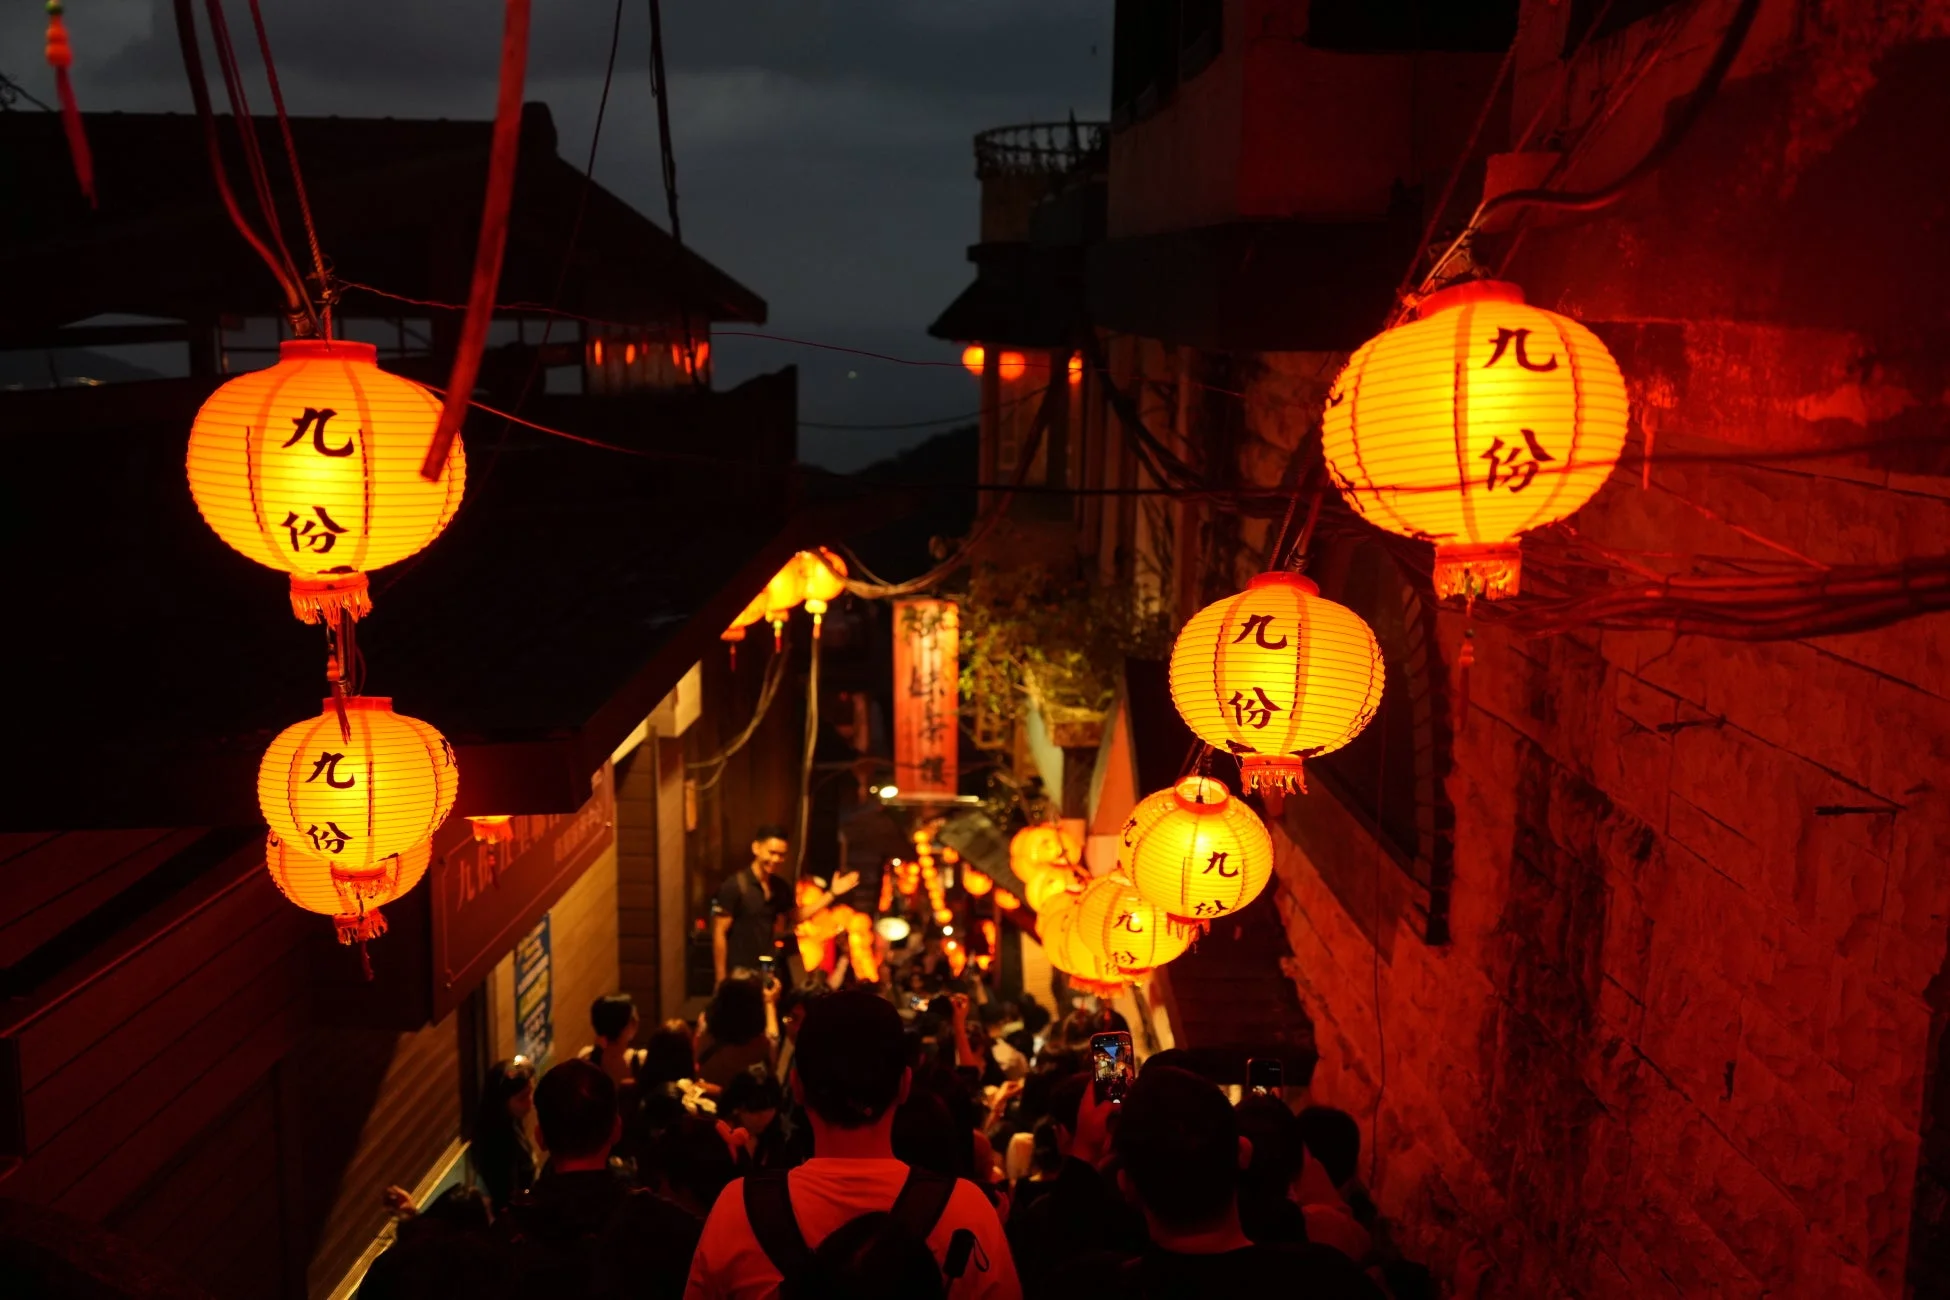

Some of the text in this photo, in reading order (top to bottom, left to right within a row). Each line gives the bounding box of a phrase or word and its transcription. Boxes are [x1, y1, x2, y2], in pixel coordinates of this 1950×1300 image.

[1480, 327, 1558, 493] 九份
[281, 407, 354, 553] 九份
[1228, 614, 1288, 729] 九份
[305, 751, 355, 854] 九份
[1194, 851, 1239, 916] 九份
